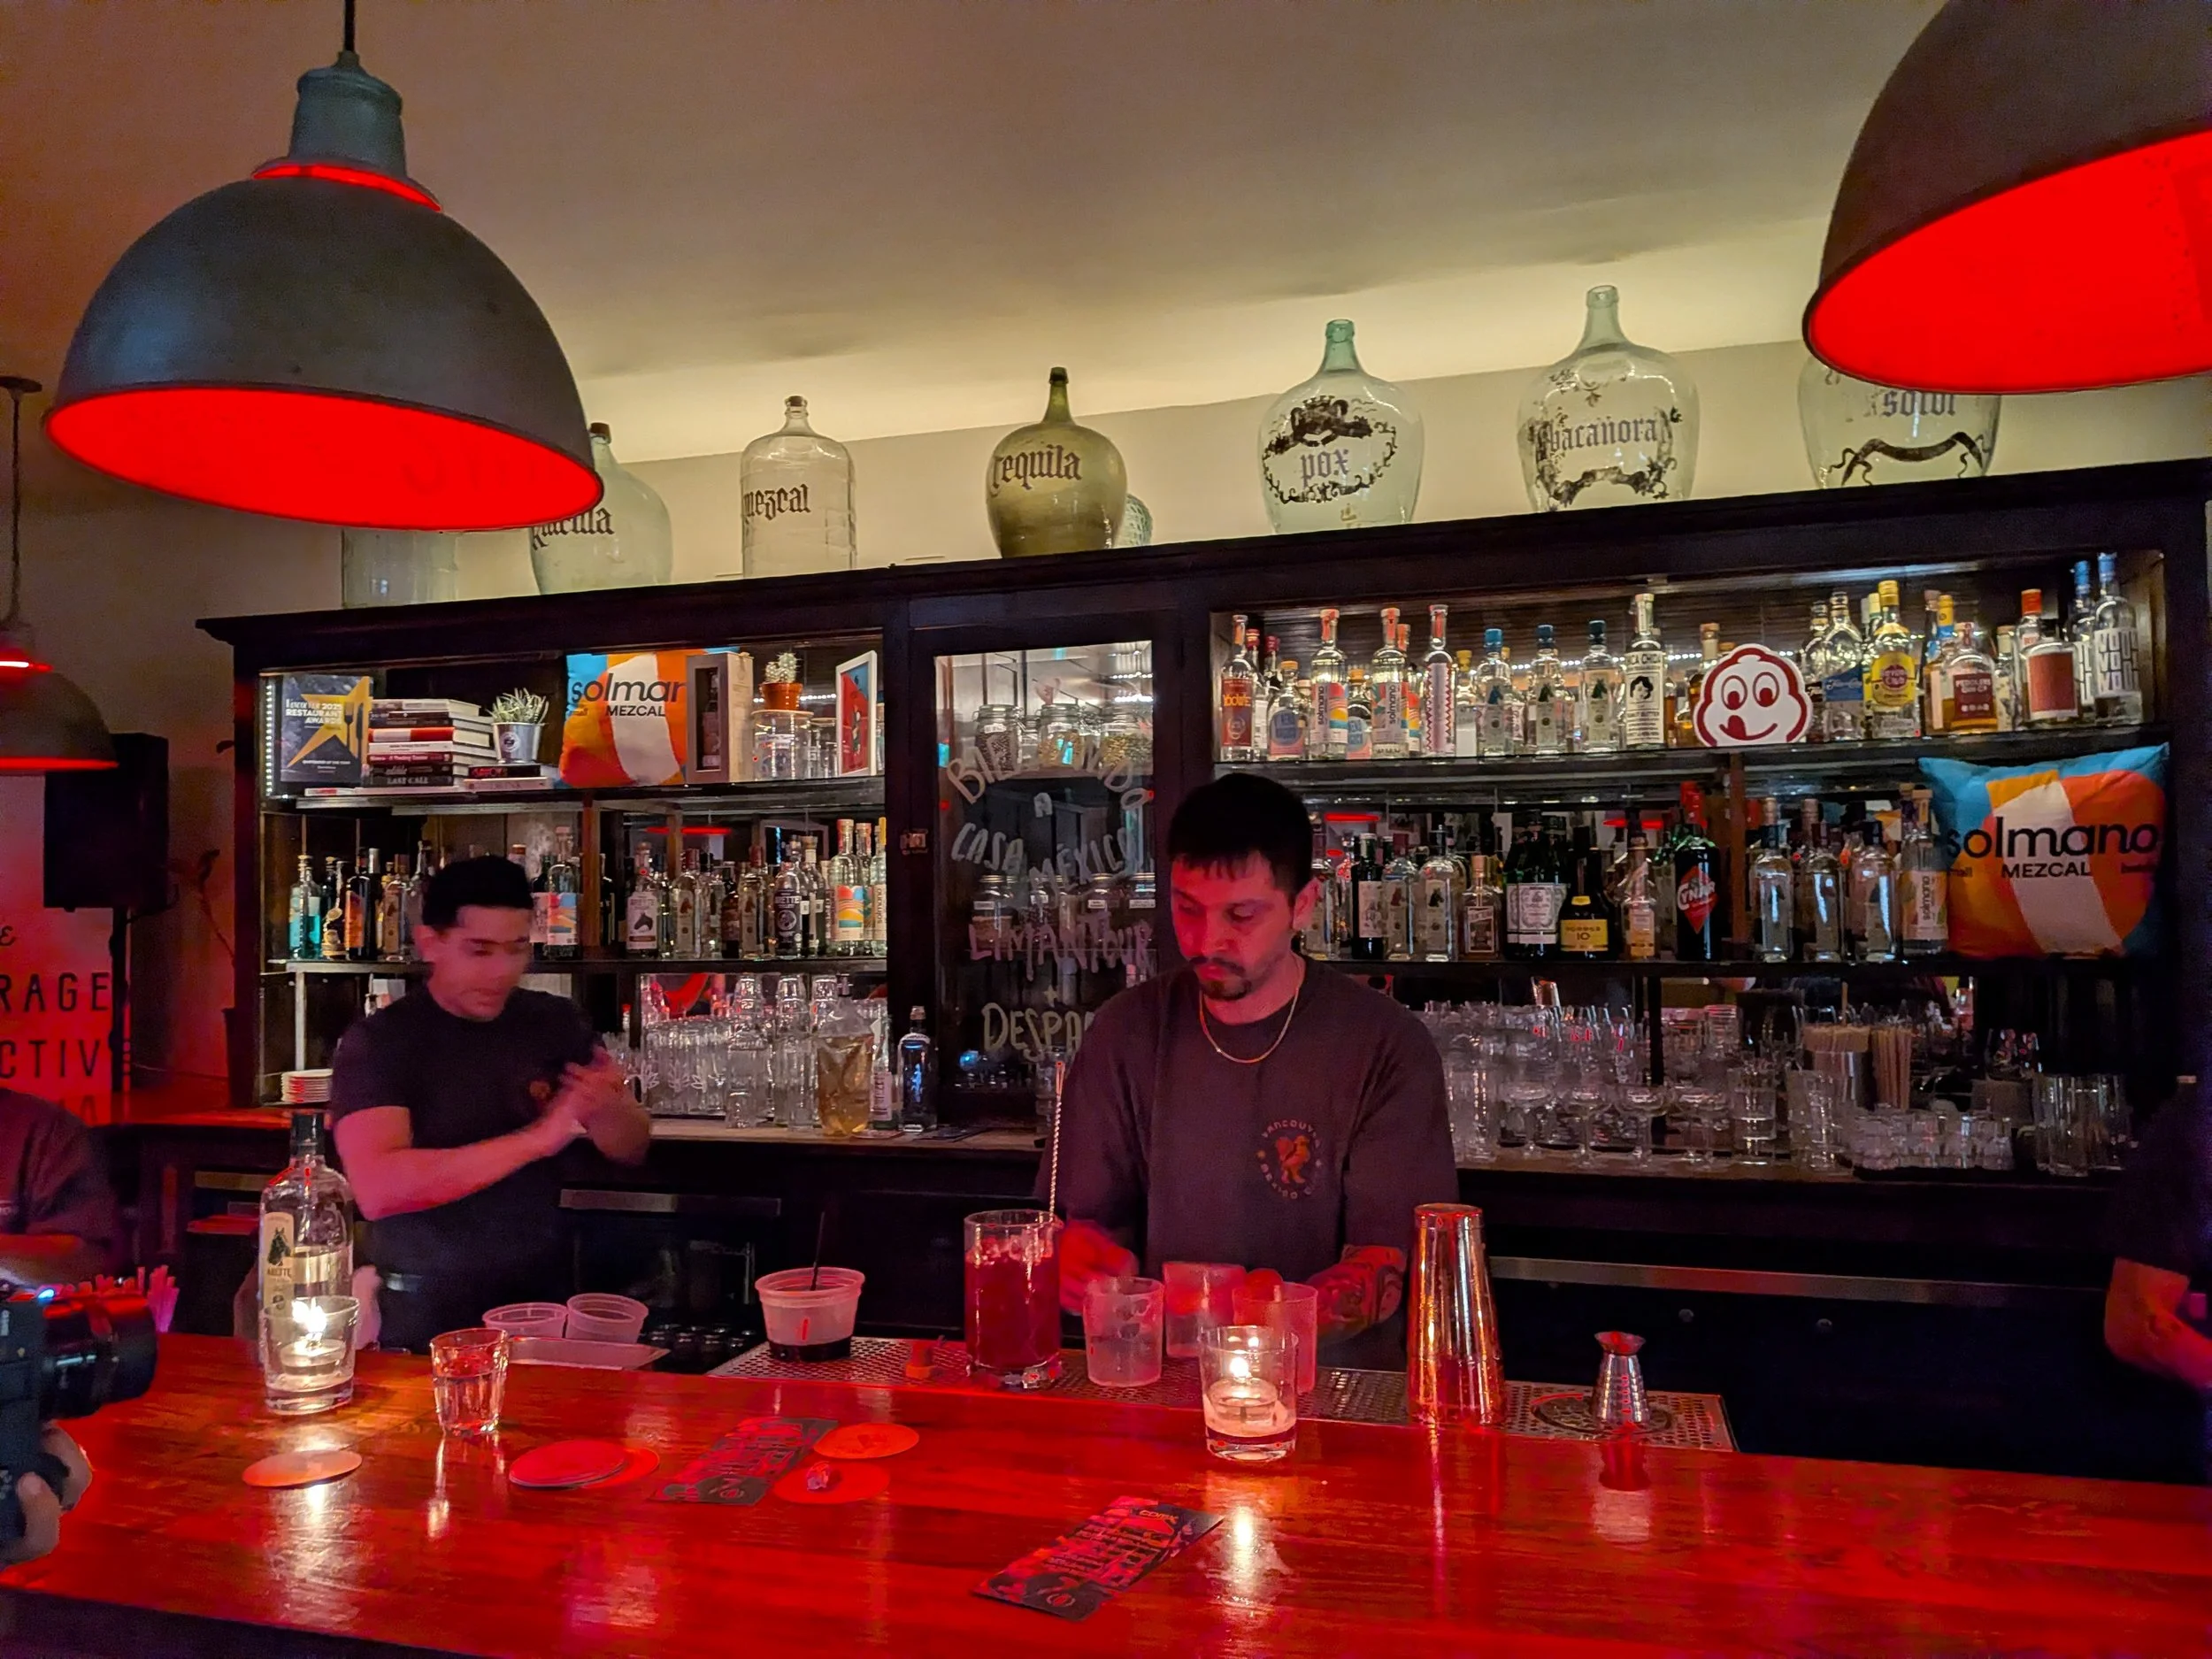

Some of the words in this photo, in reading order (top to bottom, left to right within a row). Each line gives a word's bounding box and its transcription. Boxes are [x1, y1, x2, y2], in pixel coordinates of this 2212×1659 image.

[1301, 449, 1349, 488] pox
[743, 484, 810, 524] mezcal
[572, 673, 687, 702] solman
[285, 709, 342, 718] RESTAURANT
[606, 705, 665, 717] MEZCAL
[951, 822, 1025, 872] CASA
[1947, 817, 2158, 858] solmano
[2001, 862, 2093, 878] MEZCAL
[1923, 875, 1932, 921] solmano
[1577, 932, 1590, 941] 10
[0, 972, 109, 1012] RAGE
[0, 1040, 100, 1079] CTIV
